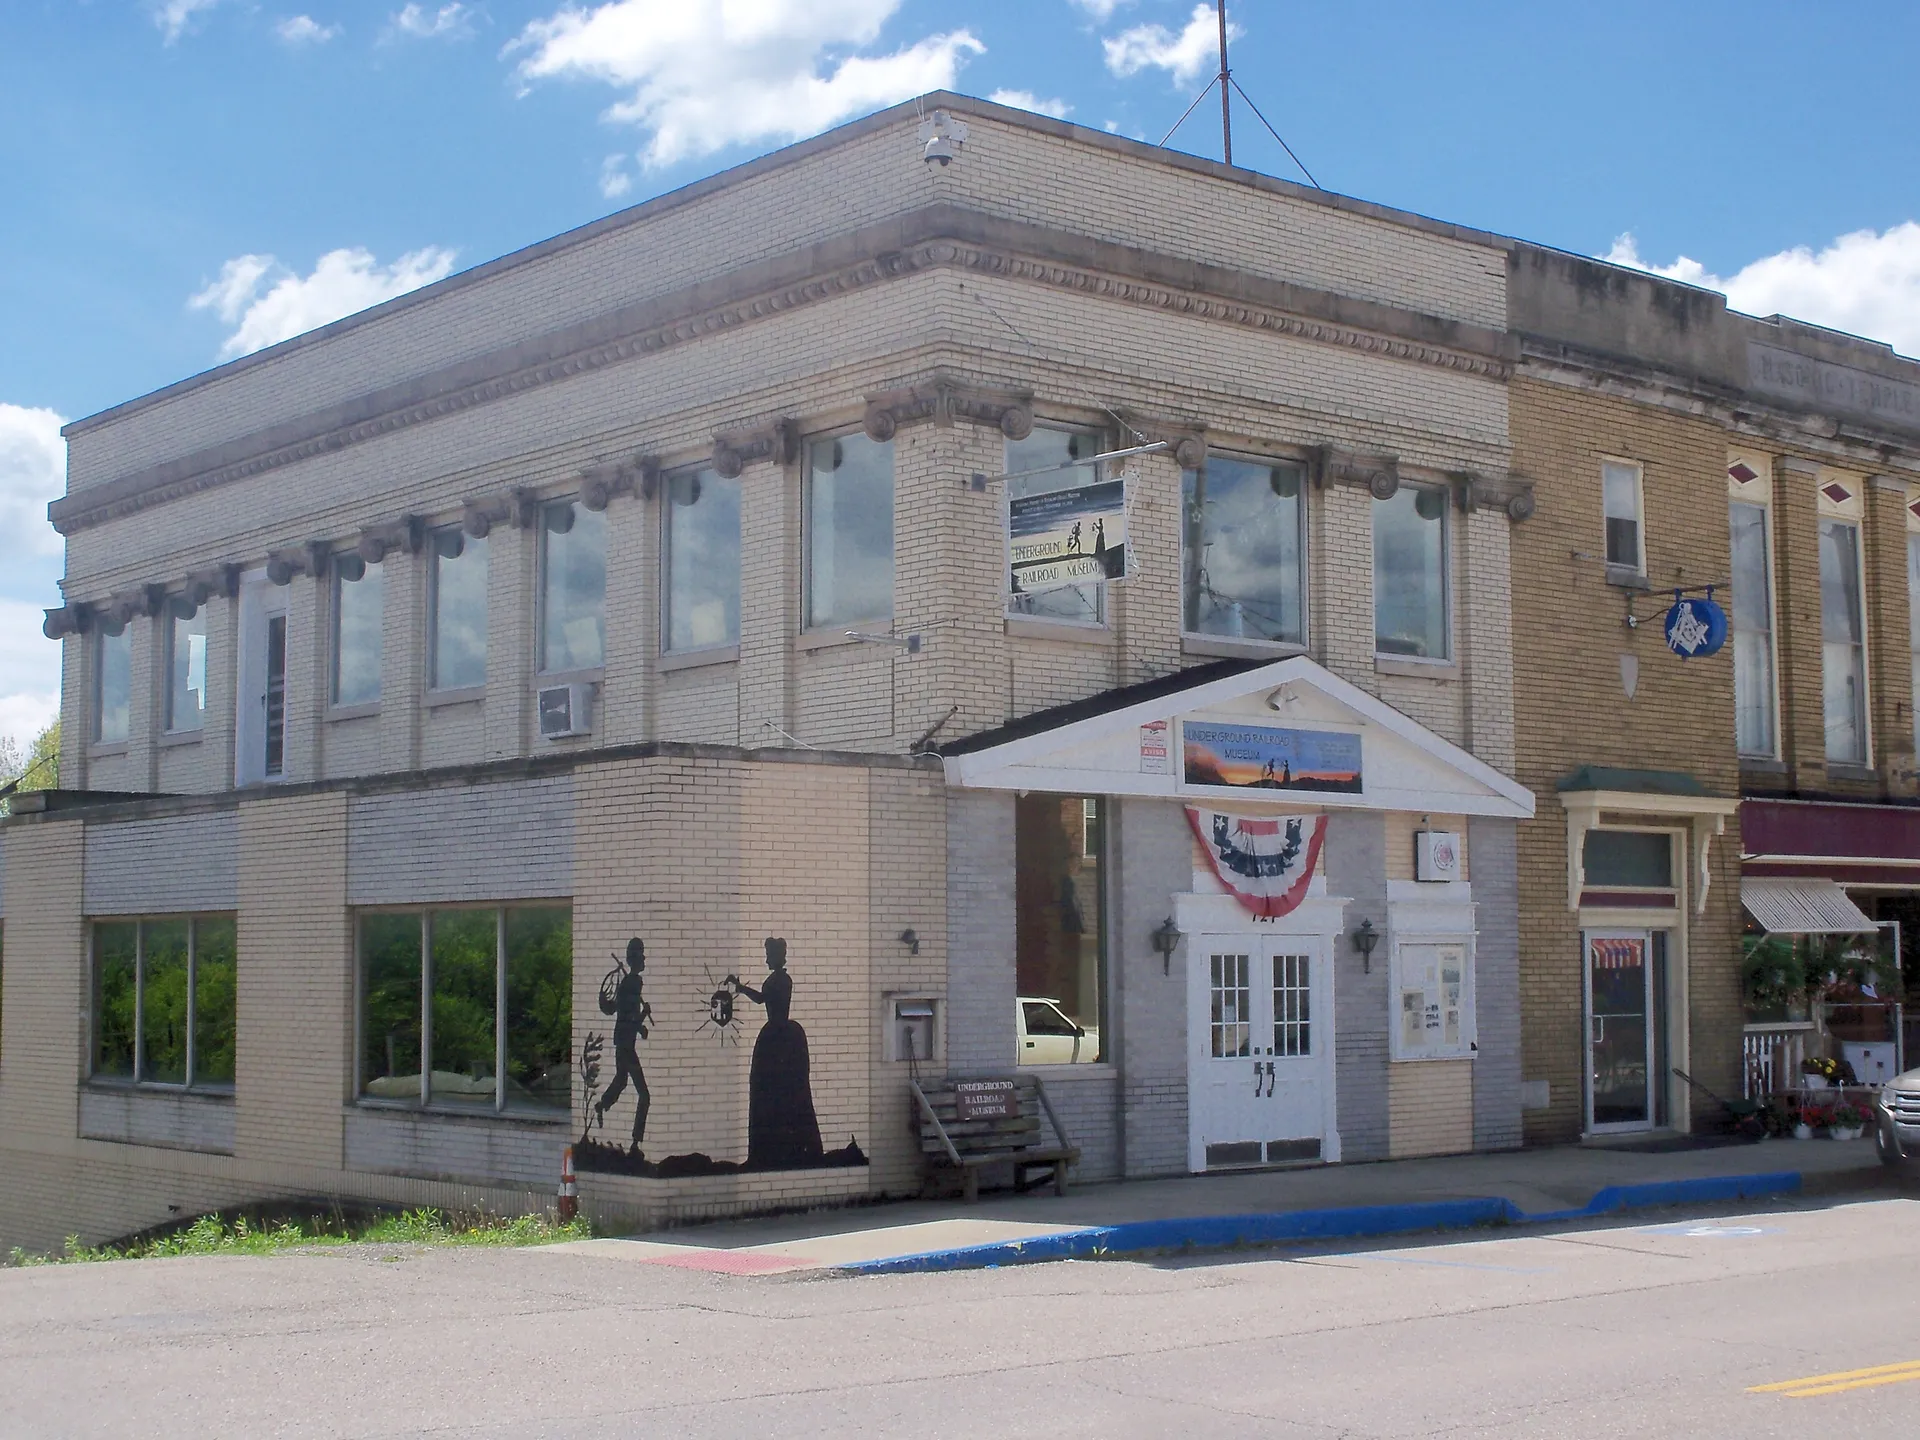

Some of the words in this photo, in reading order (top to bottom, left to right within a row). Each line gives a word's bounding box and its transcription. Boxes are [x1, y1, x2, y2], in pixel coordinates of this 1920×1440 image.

[1015, 541, 1063, 560] UNDERGROUND
[1022, 567, 1059, 584] RAILROAD
[1067, 561, 1099, 577] MUSEUM
[1187, 729, 1251, 743] UNDERGROUND
[1252, 734, 1290, 746] RAILROAD
[1224, 749, 1260, 760] MUSEUM
[957, 1081, 1014, 1092] UNDERGROUND
[971, 1105, 1007, 1115] MUSEUM
